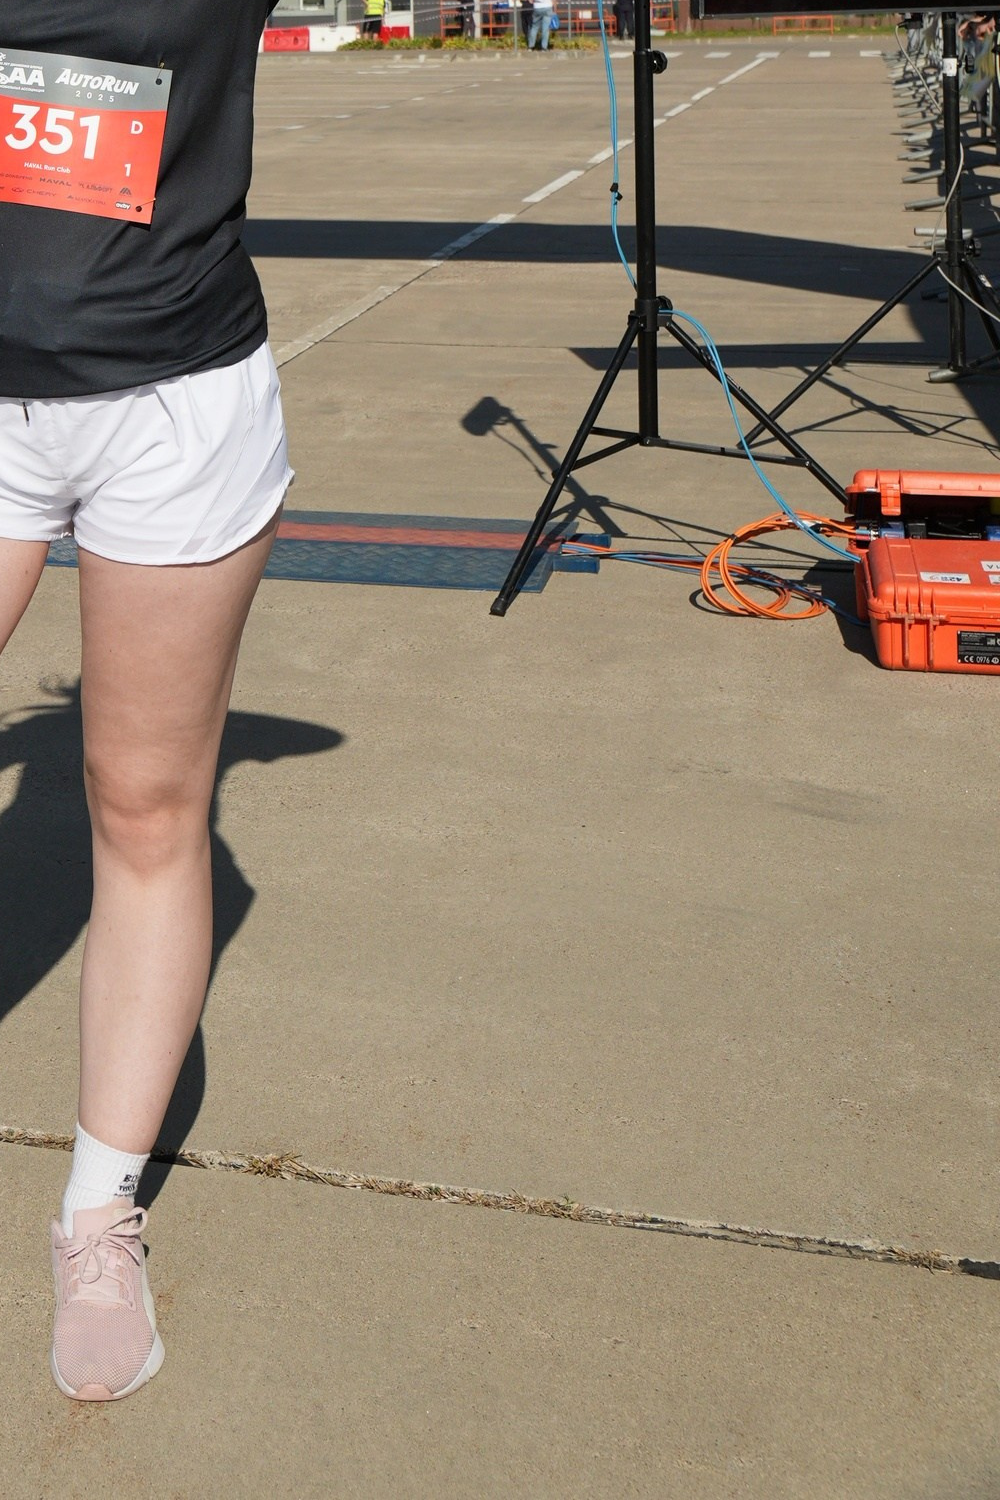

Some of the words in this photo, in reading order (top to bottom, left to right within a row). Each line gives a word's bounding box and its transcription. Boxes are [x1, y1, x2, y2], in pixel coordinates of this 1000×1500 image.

[55, 67, 140, 96] AUTORUN
[75, 90, 115, 103] 2025
[5, 104, 101, 160] 351
[130, 120, 144, 135] D
[24, 162, 43, 171] HAVAL
[56, 166, 71, 174] Club
[124, 163, 132, 177] 1
[39, 177, 72, 187] HAVAL
